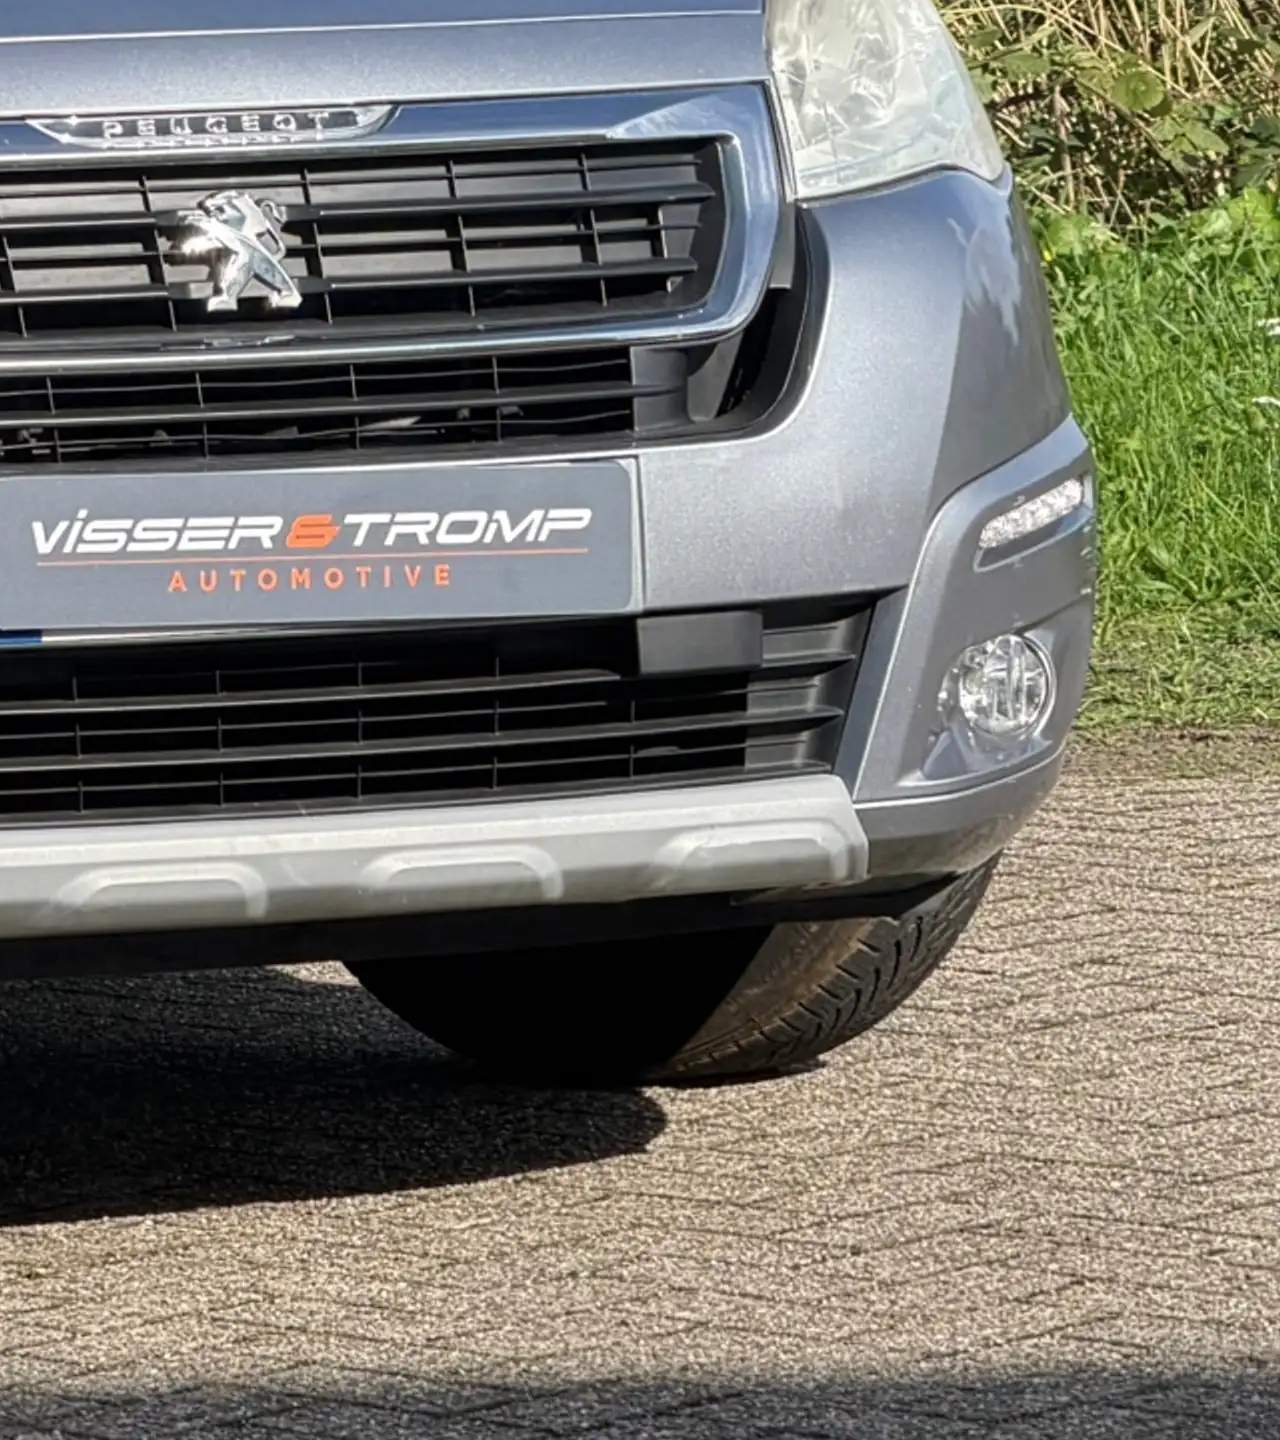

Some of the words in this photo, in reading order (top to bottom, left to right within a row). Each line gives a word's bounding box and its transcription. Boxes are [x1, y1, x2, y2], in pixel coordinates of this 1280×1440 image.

[101, 111, 329, 140] PEUGEOT
[343, 508, 593, 547] TROMP
[167, 564, 452, 594] AUTOMOTIVE
